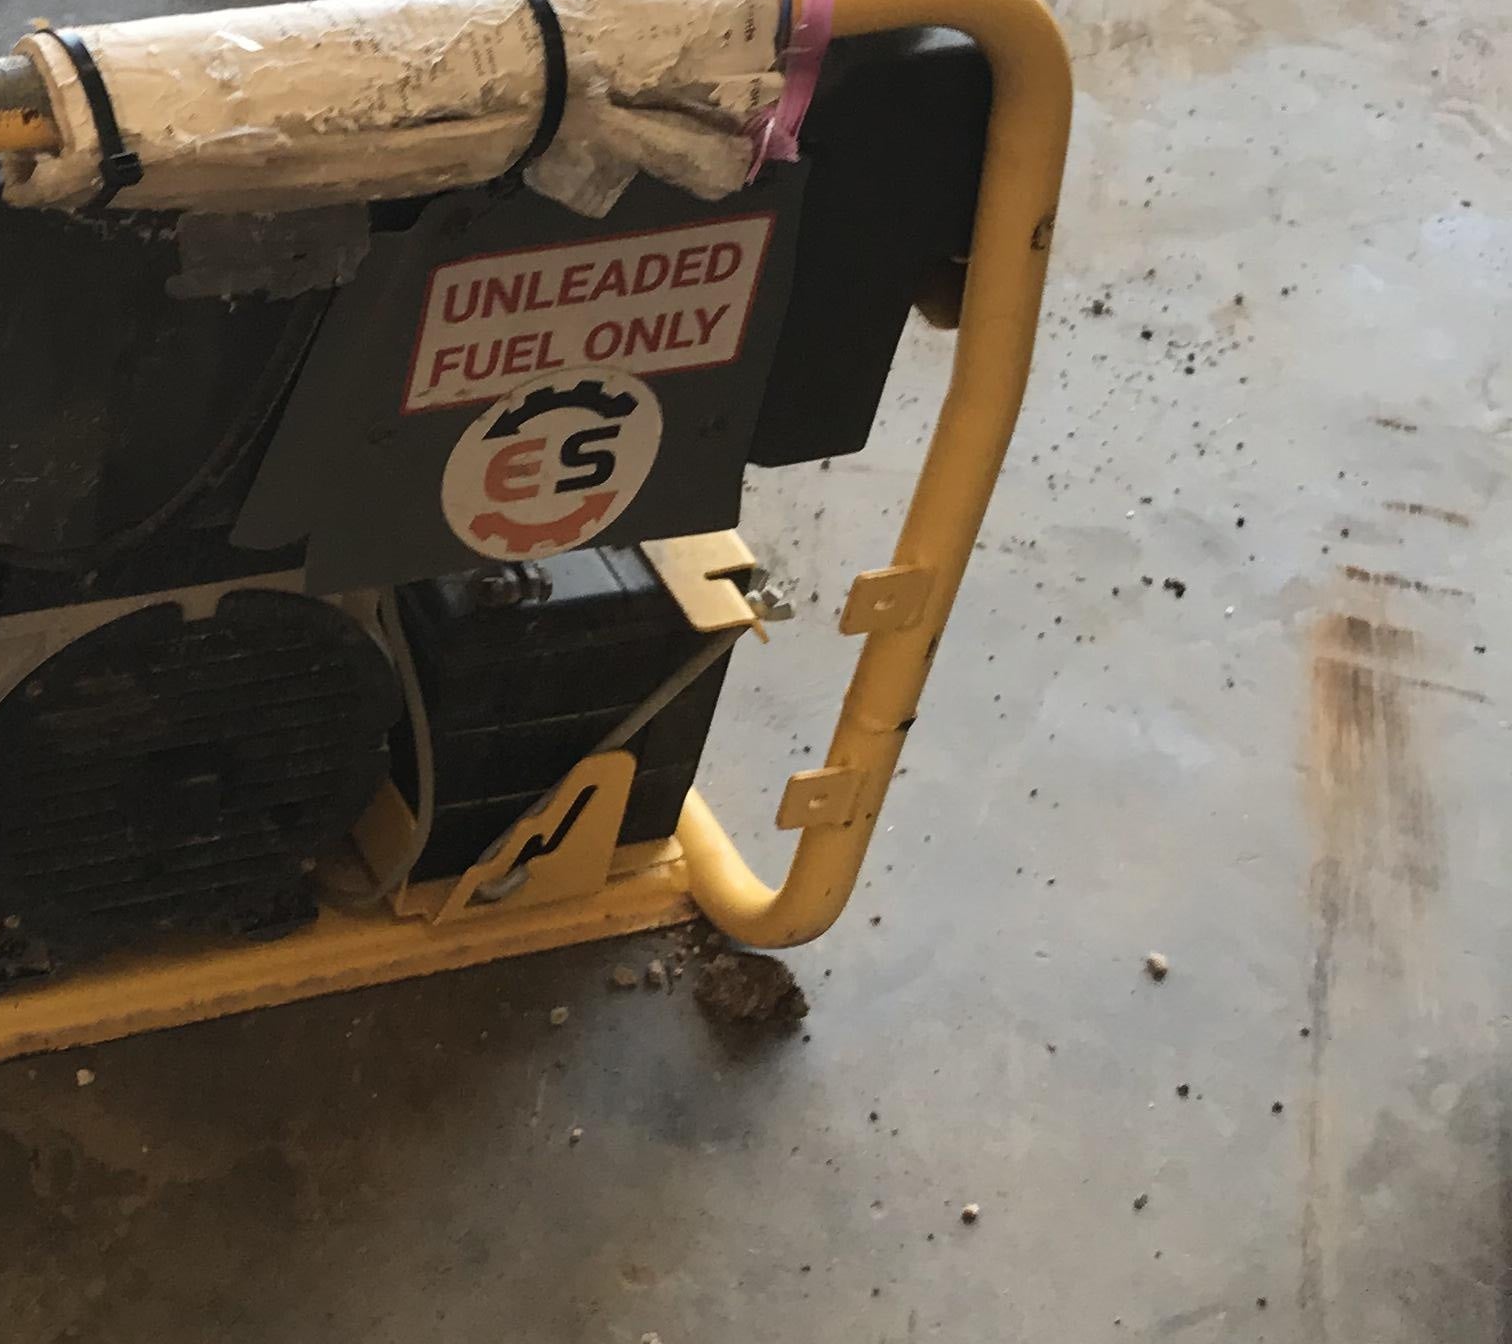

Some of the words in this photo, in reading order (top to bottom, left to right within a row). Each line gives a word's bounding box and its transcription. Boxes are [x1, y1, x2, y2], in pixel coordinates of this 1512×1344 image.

[442, 241, 743, 325] UNLEADED
[428, 330, 565, 388] FUEL
[583, 303, 731, 362] ONLY
[483, 424, 622, 504] ES
